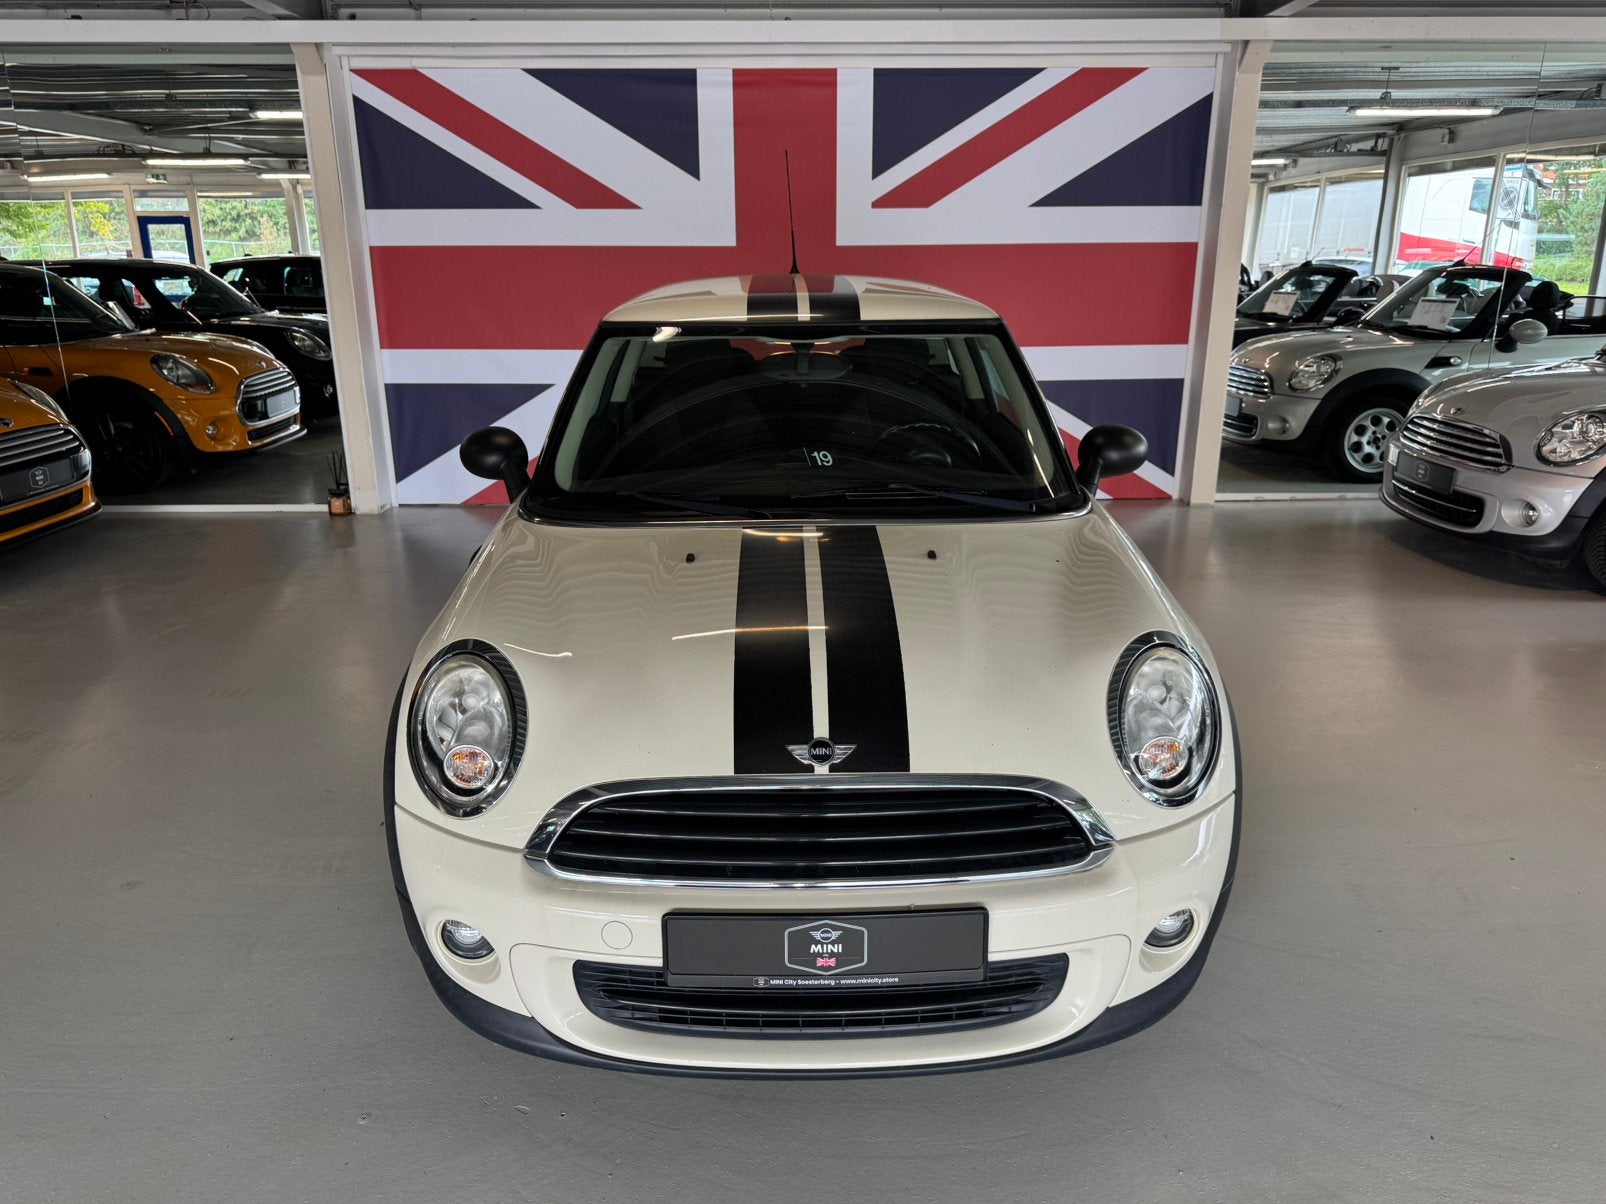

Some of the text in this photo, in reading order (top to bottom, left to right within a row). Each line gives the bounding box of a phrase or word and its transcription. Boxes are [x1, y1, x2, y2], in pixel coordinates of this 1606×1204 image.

[812, 451, 832, 466] 19
[810, 747, 833, 755] MINI
[810, 944, 842, 953] MINI
